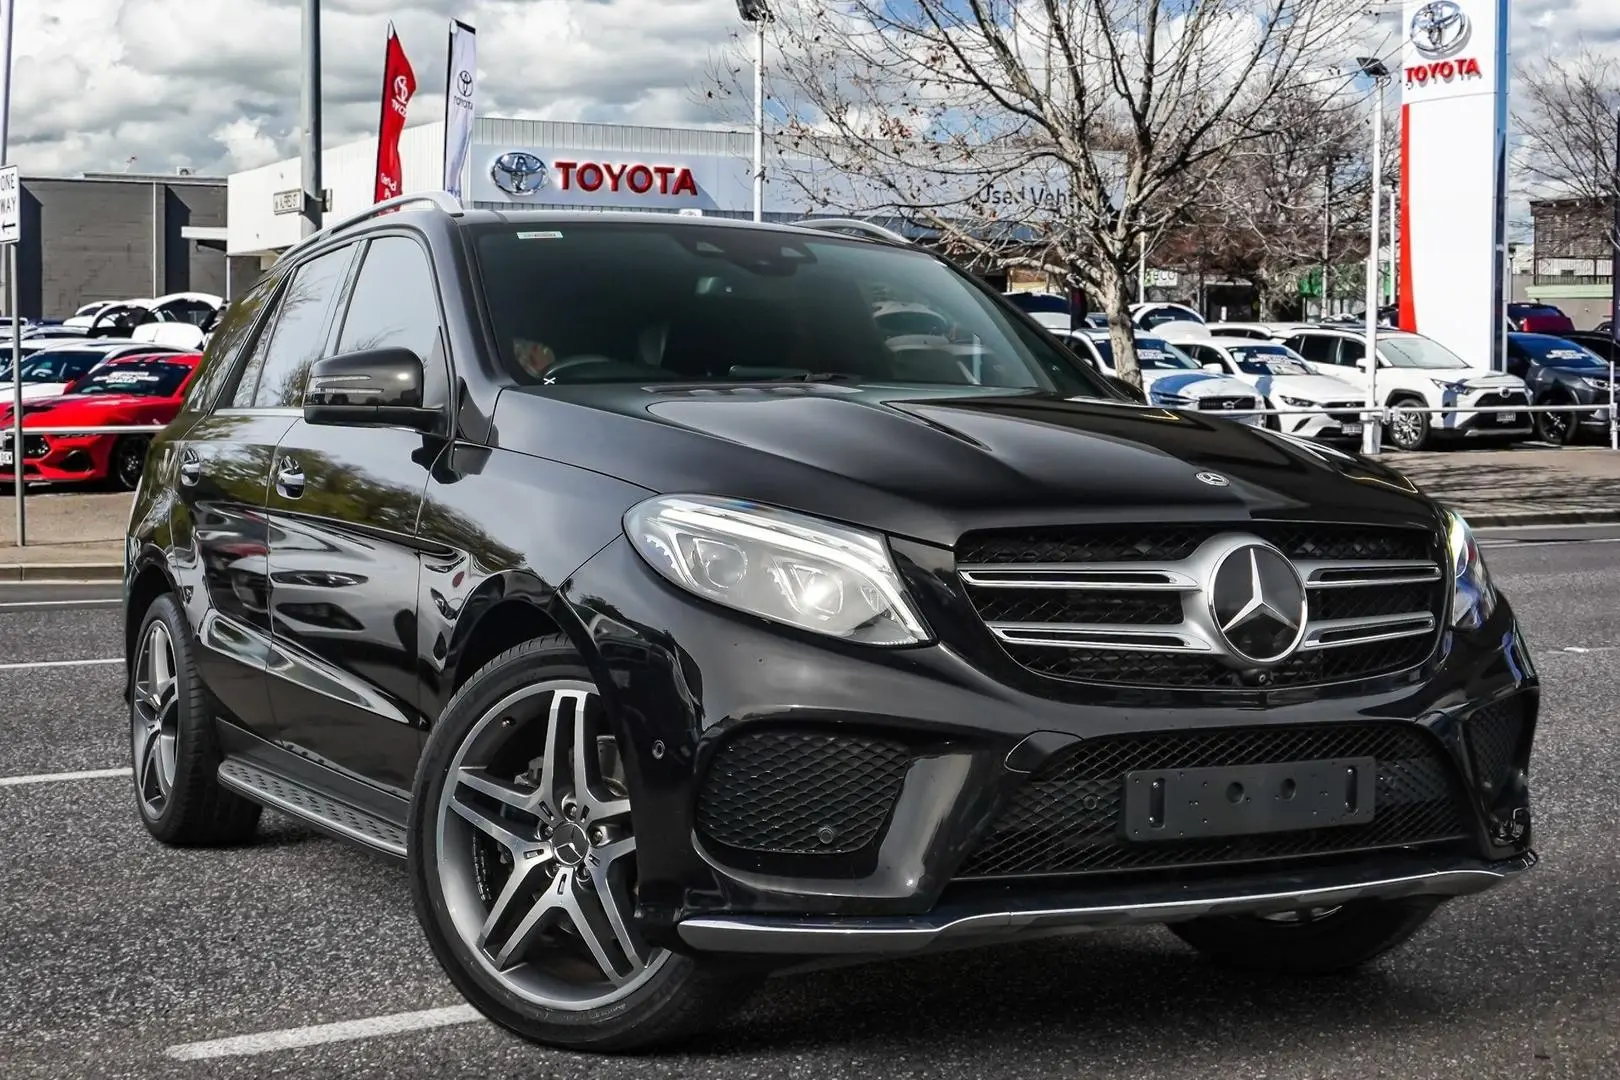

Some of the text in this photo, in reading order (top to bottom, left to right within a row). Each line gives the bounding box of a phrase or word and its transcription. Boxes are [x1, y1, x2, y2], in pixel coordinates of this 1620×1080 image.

[1404, 58, 1481, 84] TOYOTA
[1, 173, 15, 191] ONE
[555, 161, 698, 196] TOYOTA
